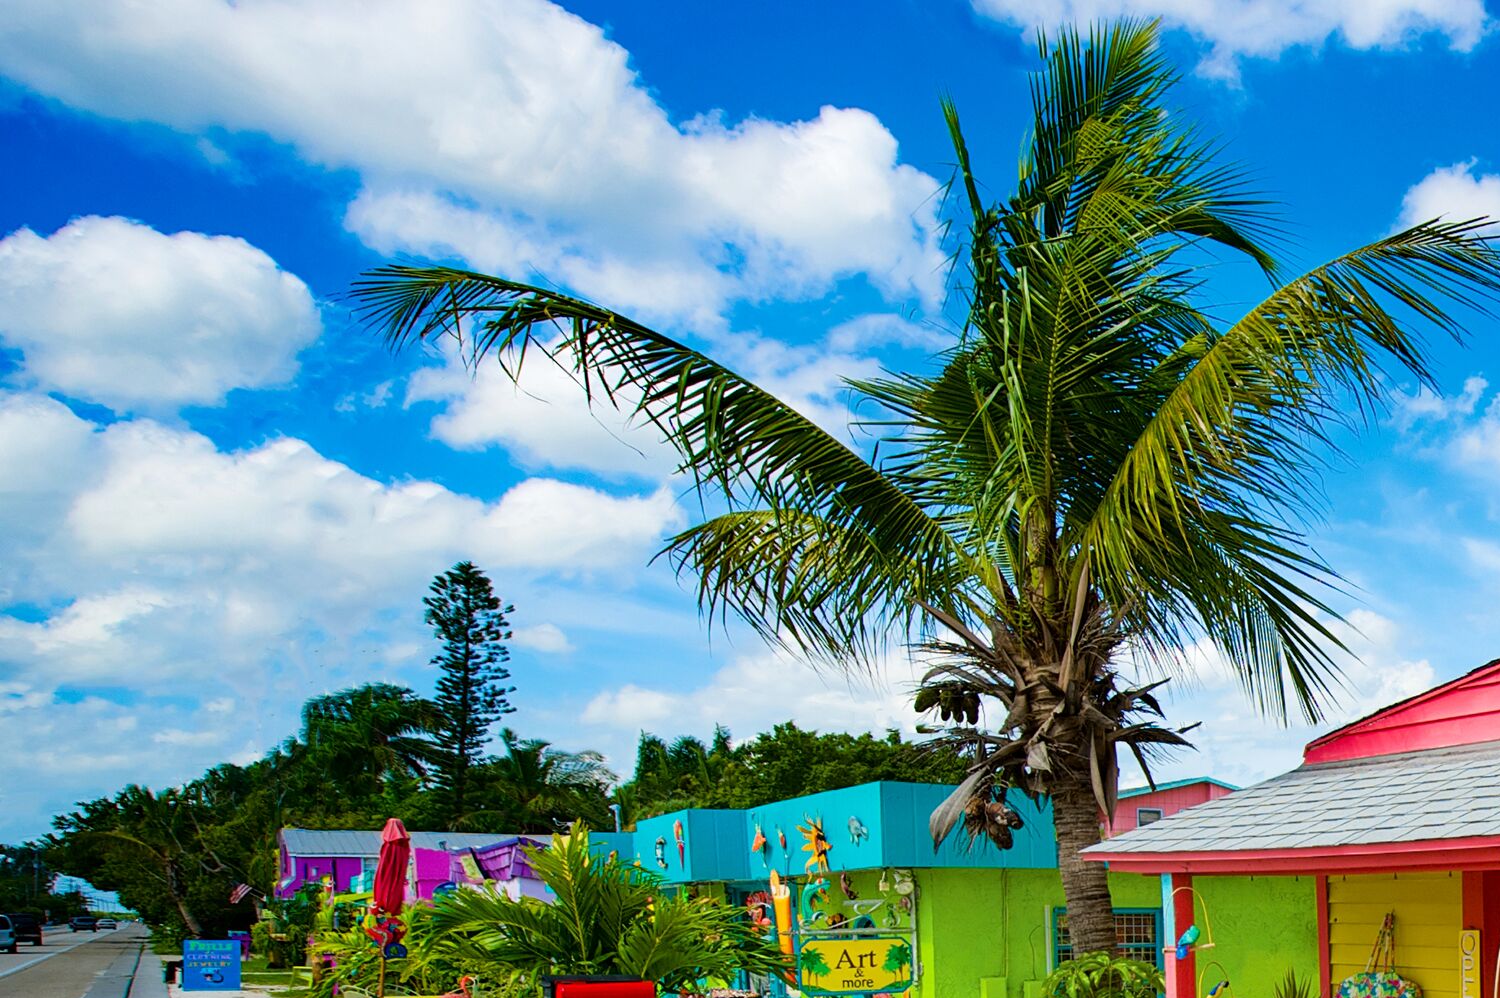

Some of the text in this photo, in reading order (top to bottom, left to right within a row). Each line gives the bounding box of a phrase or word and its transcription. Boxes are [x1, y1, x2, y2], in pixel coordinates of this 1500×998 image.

[835, 949, 877, 969] Art
[854, 967, 865, 978] &
[842, 979, 874, 988] more
